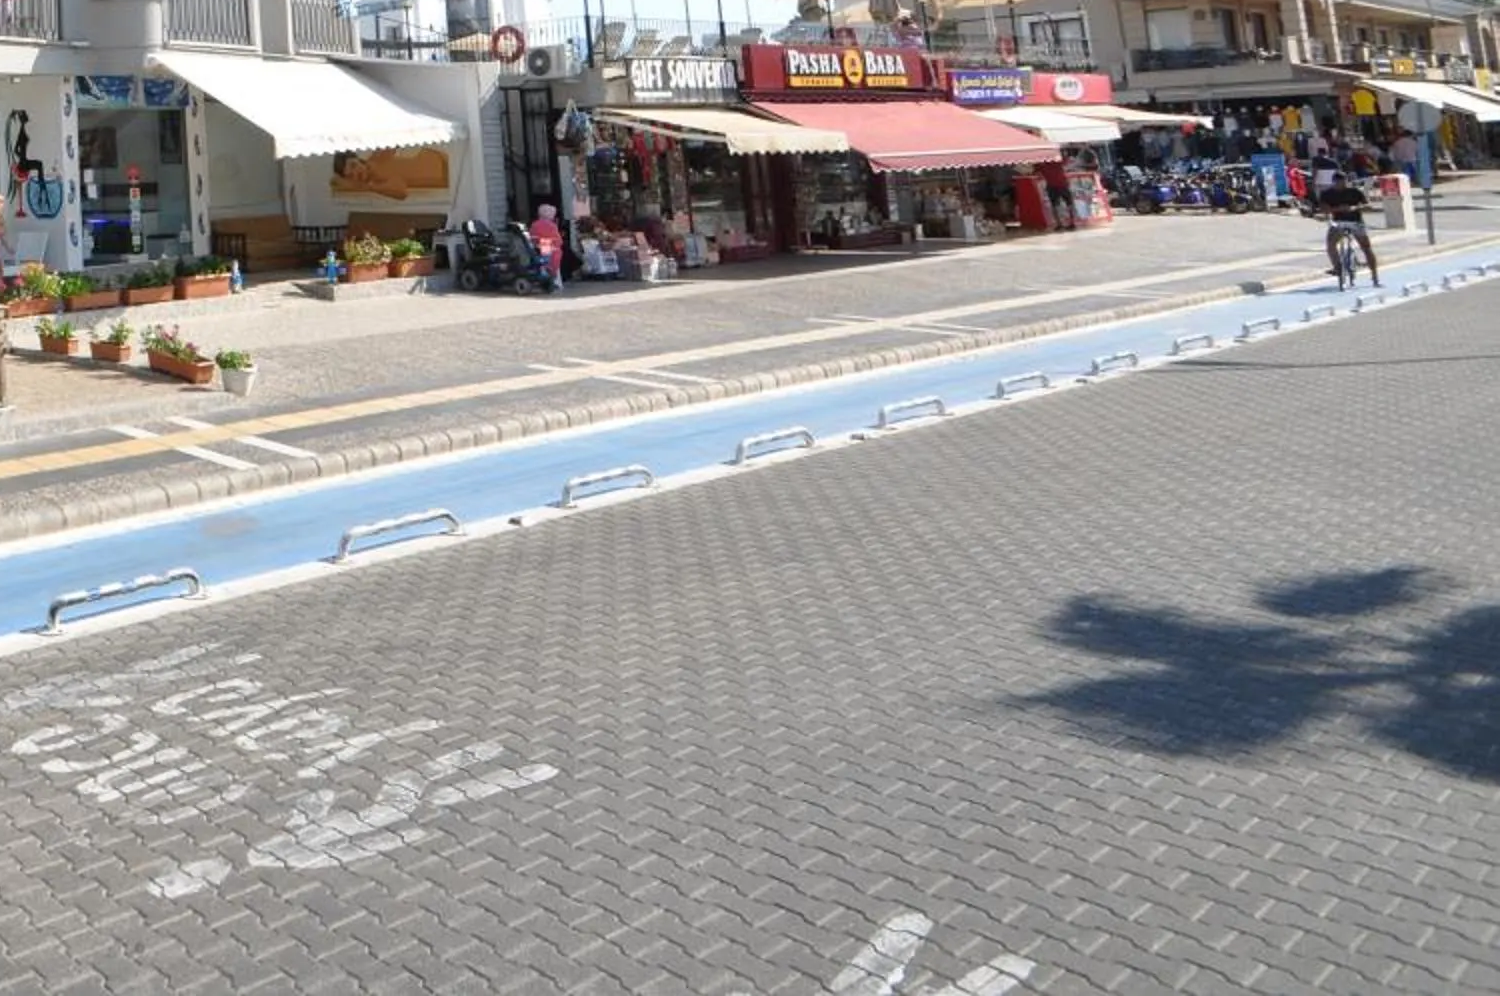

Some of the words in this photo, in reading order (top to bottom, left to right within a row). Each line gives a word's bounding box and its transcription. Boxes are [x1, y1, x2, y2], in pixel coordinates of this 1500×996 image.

[631, 59, 663, 89] GIFT
[788, 49, 841, 75] PASHA
[864, 50, 905, 75] BABA
